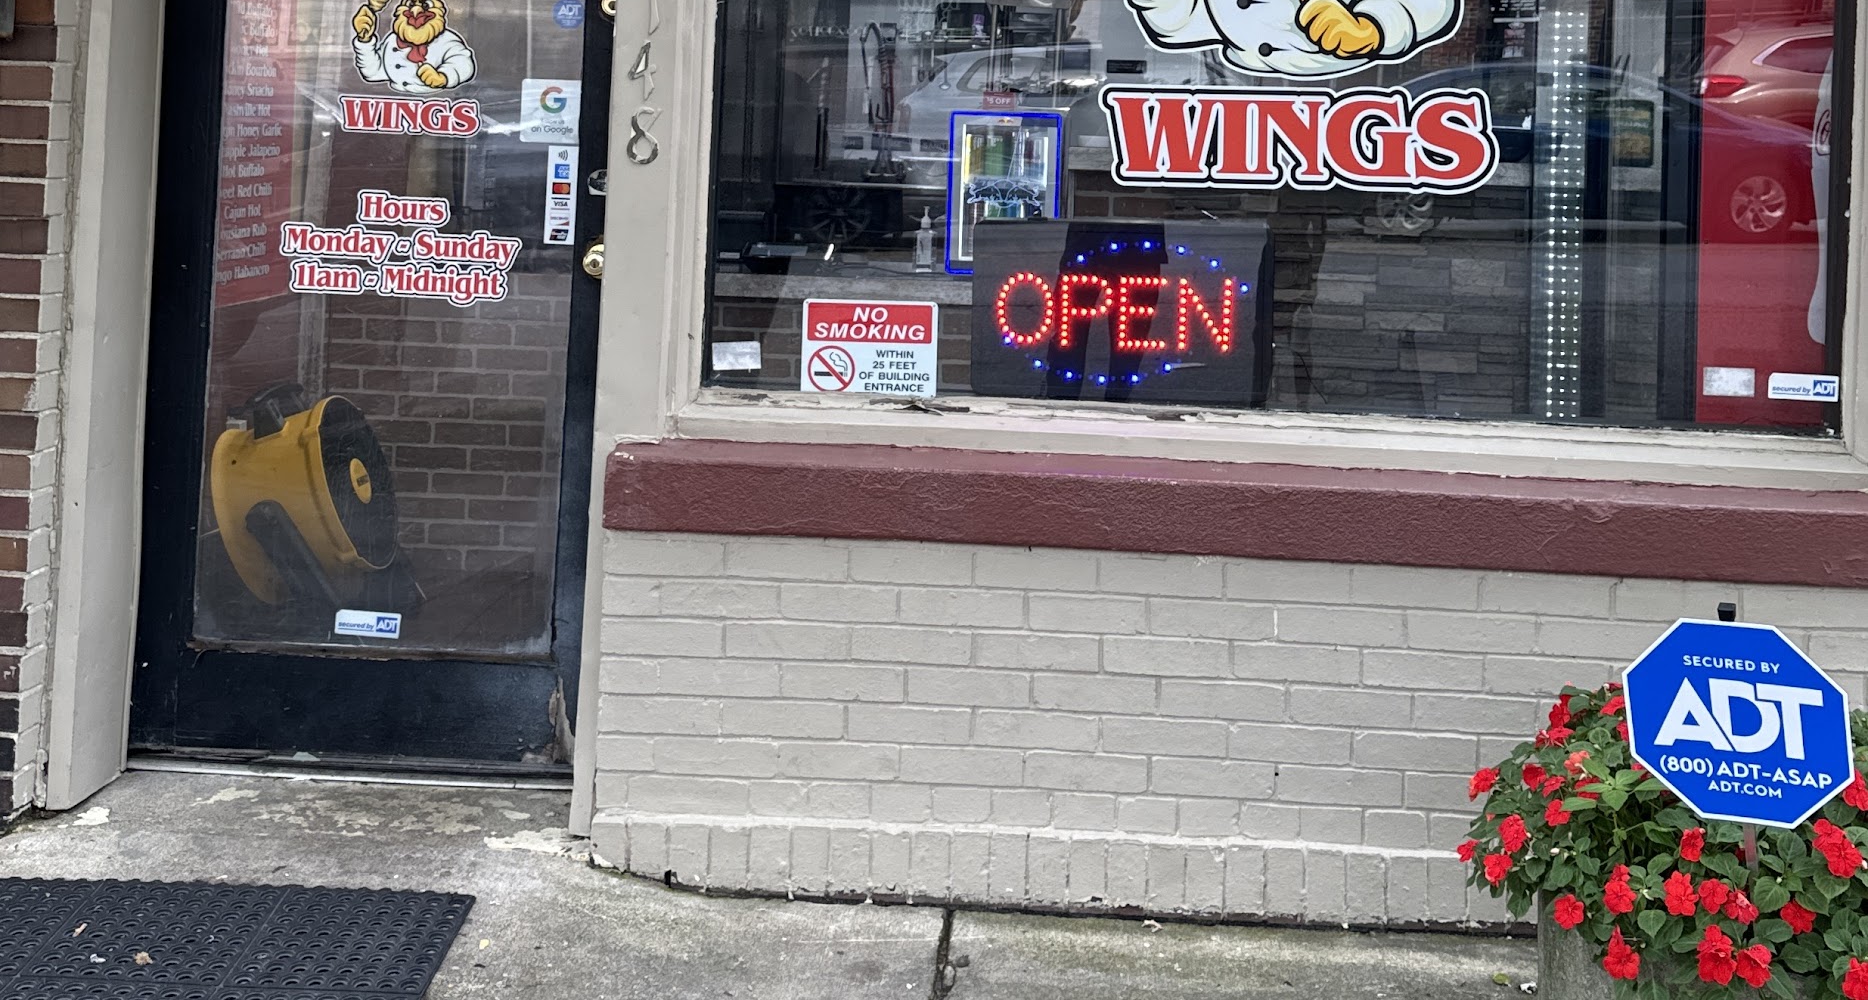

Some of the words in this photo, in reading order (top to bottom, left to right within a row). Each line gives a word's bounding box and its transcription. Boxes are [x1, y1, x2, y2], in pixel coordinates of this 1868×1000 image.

[558, 4, 581, 16] ADT
[227, 102, 257, 117] ashville
[340, 97, 479, 134] WINGS
[543, 125, 574, 135] Google
[1107, 91, 1491, 186] WINGS
[359, 193, 447, 224] Hours
[283, 225, 395, 262] Monday
[414, 231, 519, 268] Sunday
[294, 262, 360, 290] 11am
[382, 266, 502, 302] Midnight
[852, 306, 889, 323] NO
[997, 271, 1234, 352] OPEN
[814, 322, 926, 341] SMOKING
[876, 349, 915, 359] WITHIN
[872, 360, 885, 370] 25
[889, 361, 917, 370] FEET
[858, 371, 874, 380] OF
[878, 372, 930, 382] BUILDING
[864, 382, 925, 393] ENTRANCE
[1772, 385, 1802, 393] secured
[1802, 386, 1811, 395] by
[1813, 381, 1835, 395] ADT
[338, 621, 366, 629] secured
[366, 622, 375, 630] by
[377, 618, 397, 632] ADT
[1683, 654, 1756, 671] SECURED
[1760, 661, 1781, 674] BY
[1653, 676, 1824, 761] ADT
[1659, 754, 1714, 778] (800)
[1716, 761, 1833, 790] ADT-ASAP
[1708, 779, 1782, 799] ADT.COM
